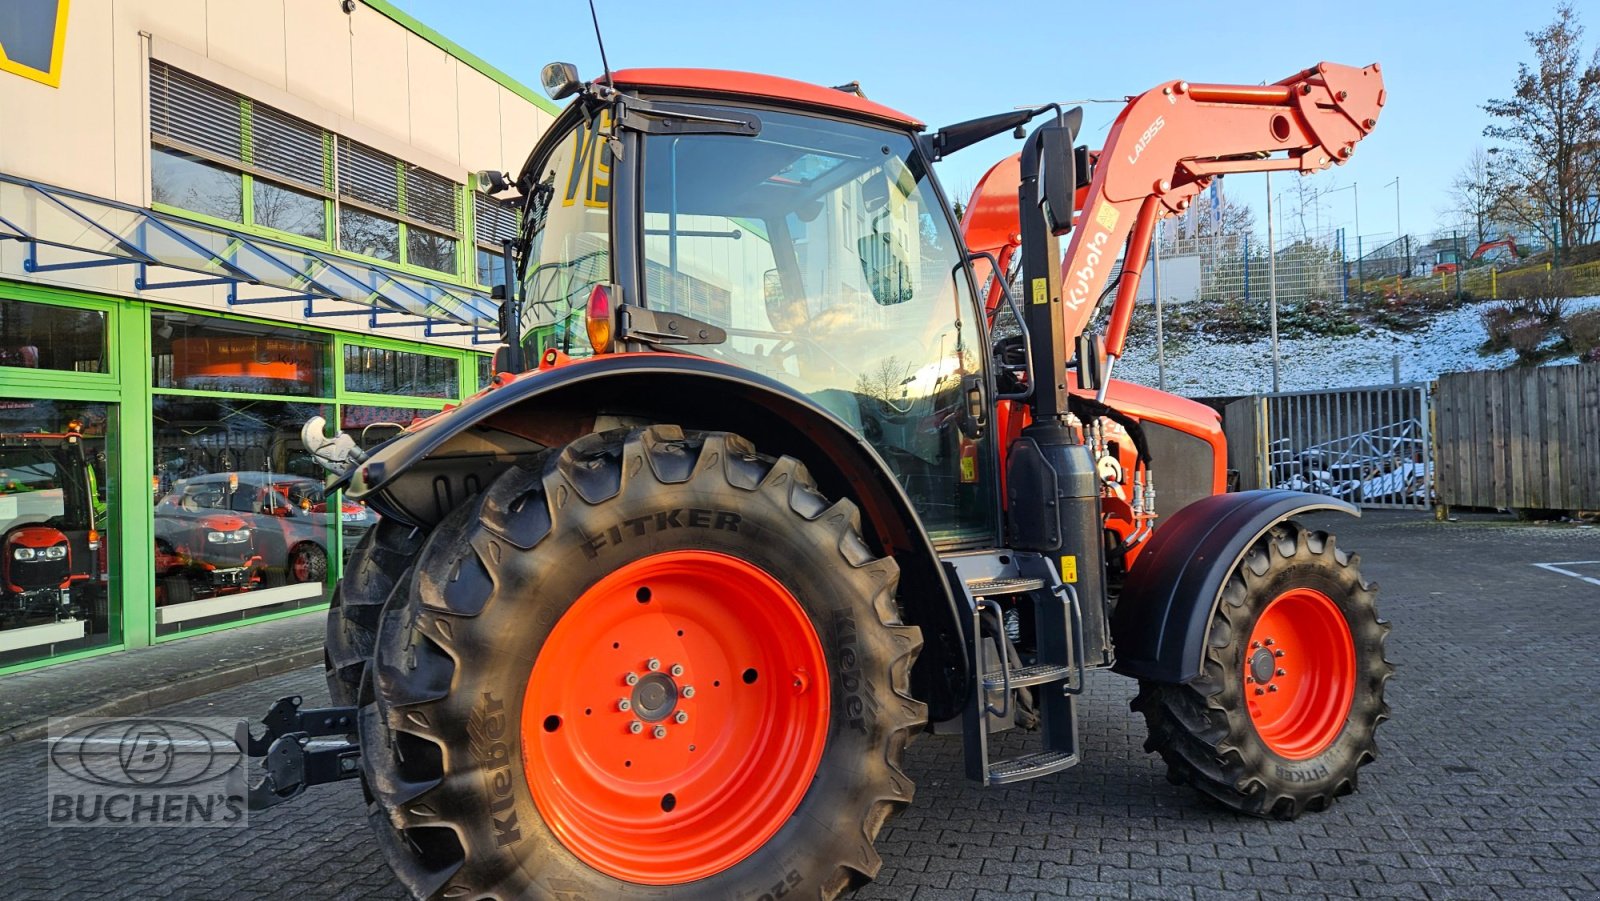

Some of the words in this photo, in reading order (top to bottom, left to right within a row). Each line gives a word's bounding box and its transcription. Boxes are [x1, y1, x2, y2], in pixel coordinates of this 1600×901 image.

[1065, 231, 1109, 312] Kubota
[578, 506, 745, 561] FITKER
[832, 607, 868, 736] Kleber
[483, 692, 523, 849] Kleber
[1275, 764, 1330, 783] FITKER
